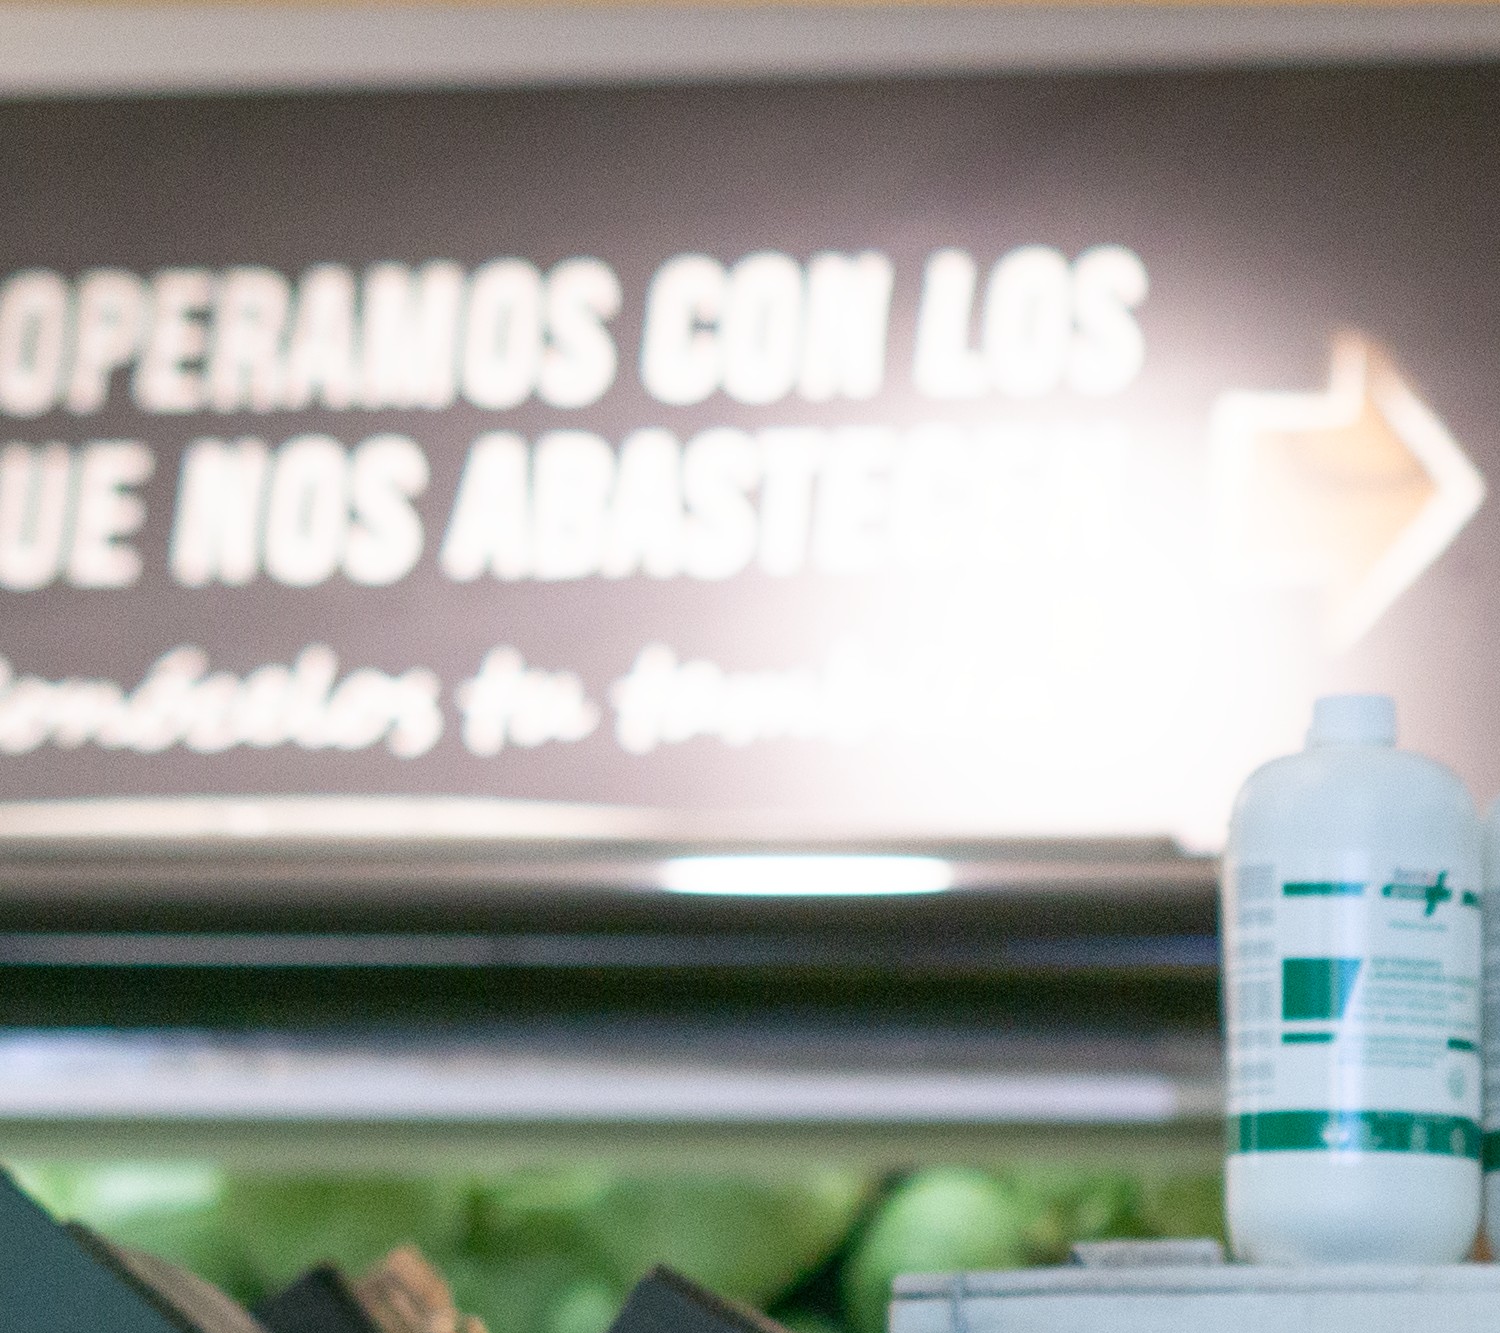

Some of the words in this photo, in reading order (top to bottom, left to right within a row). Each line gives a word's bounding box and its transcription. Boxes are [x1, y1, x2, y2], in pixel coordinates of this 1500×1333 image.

[642, 251, 894, 406] CON
[912, 244, 1148, 400] LOS
[173, 432, 429, 588] NOS
[440, 423, 1131, 584] ABASTE
